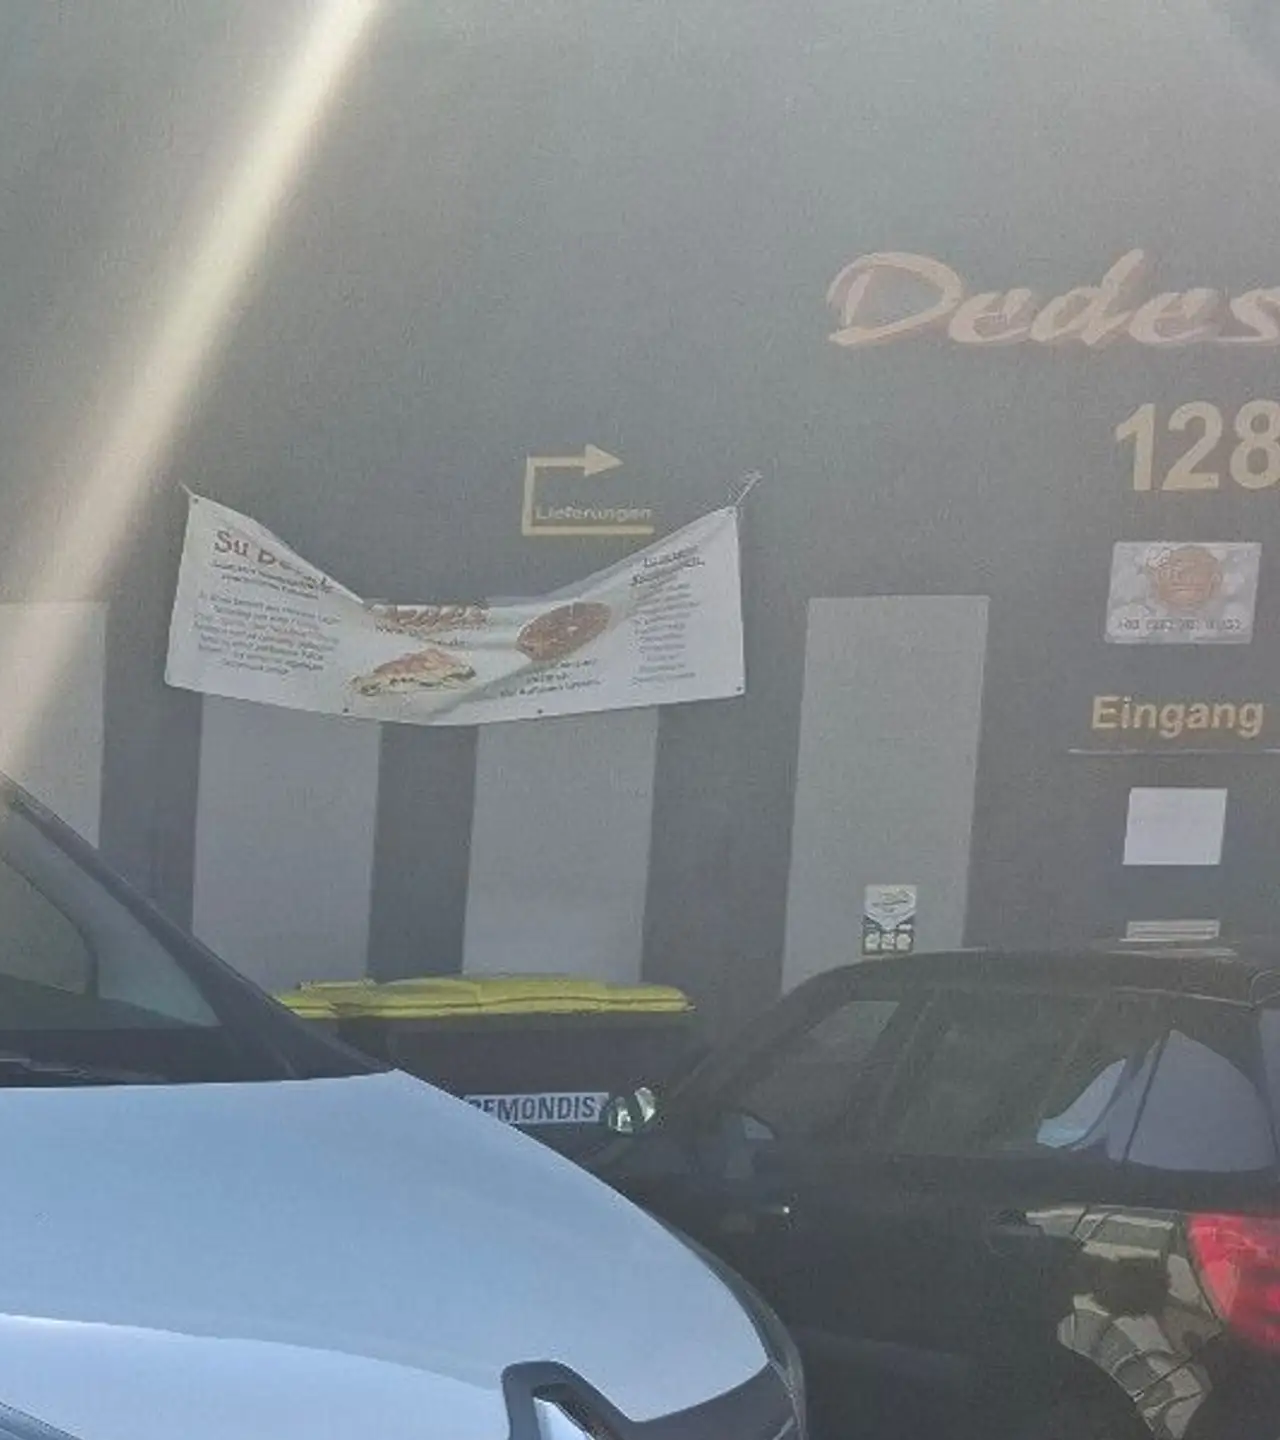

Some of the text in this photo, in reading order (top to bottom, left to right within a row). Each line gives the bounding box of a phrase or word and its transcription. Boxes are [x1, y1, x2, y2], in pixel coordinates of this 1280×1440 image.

[1116, 399, 1280, 491] 128
[536, 505, 652, 523] Lieferungen
[1091, 694, 1264, 738] Eingang
